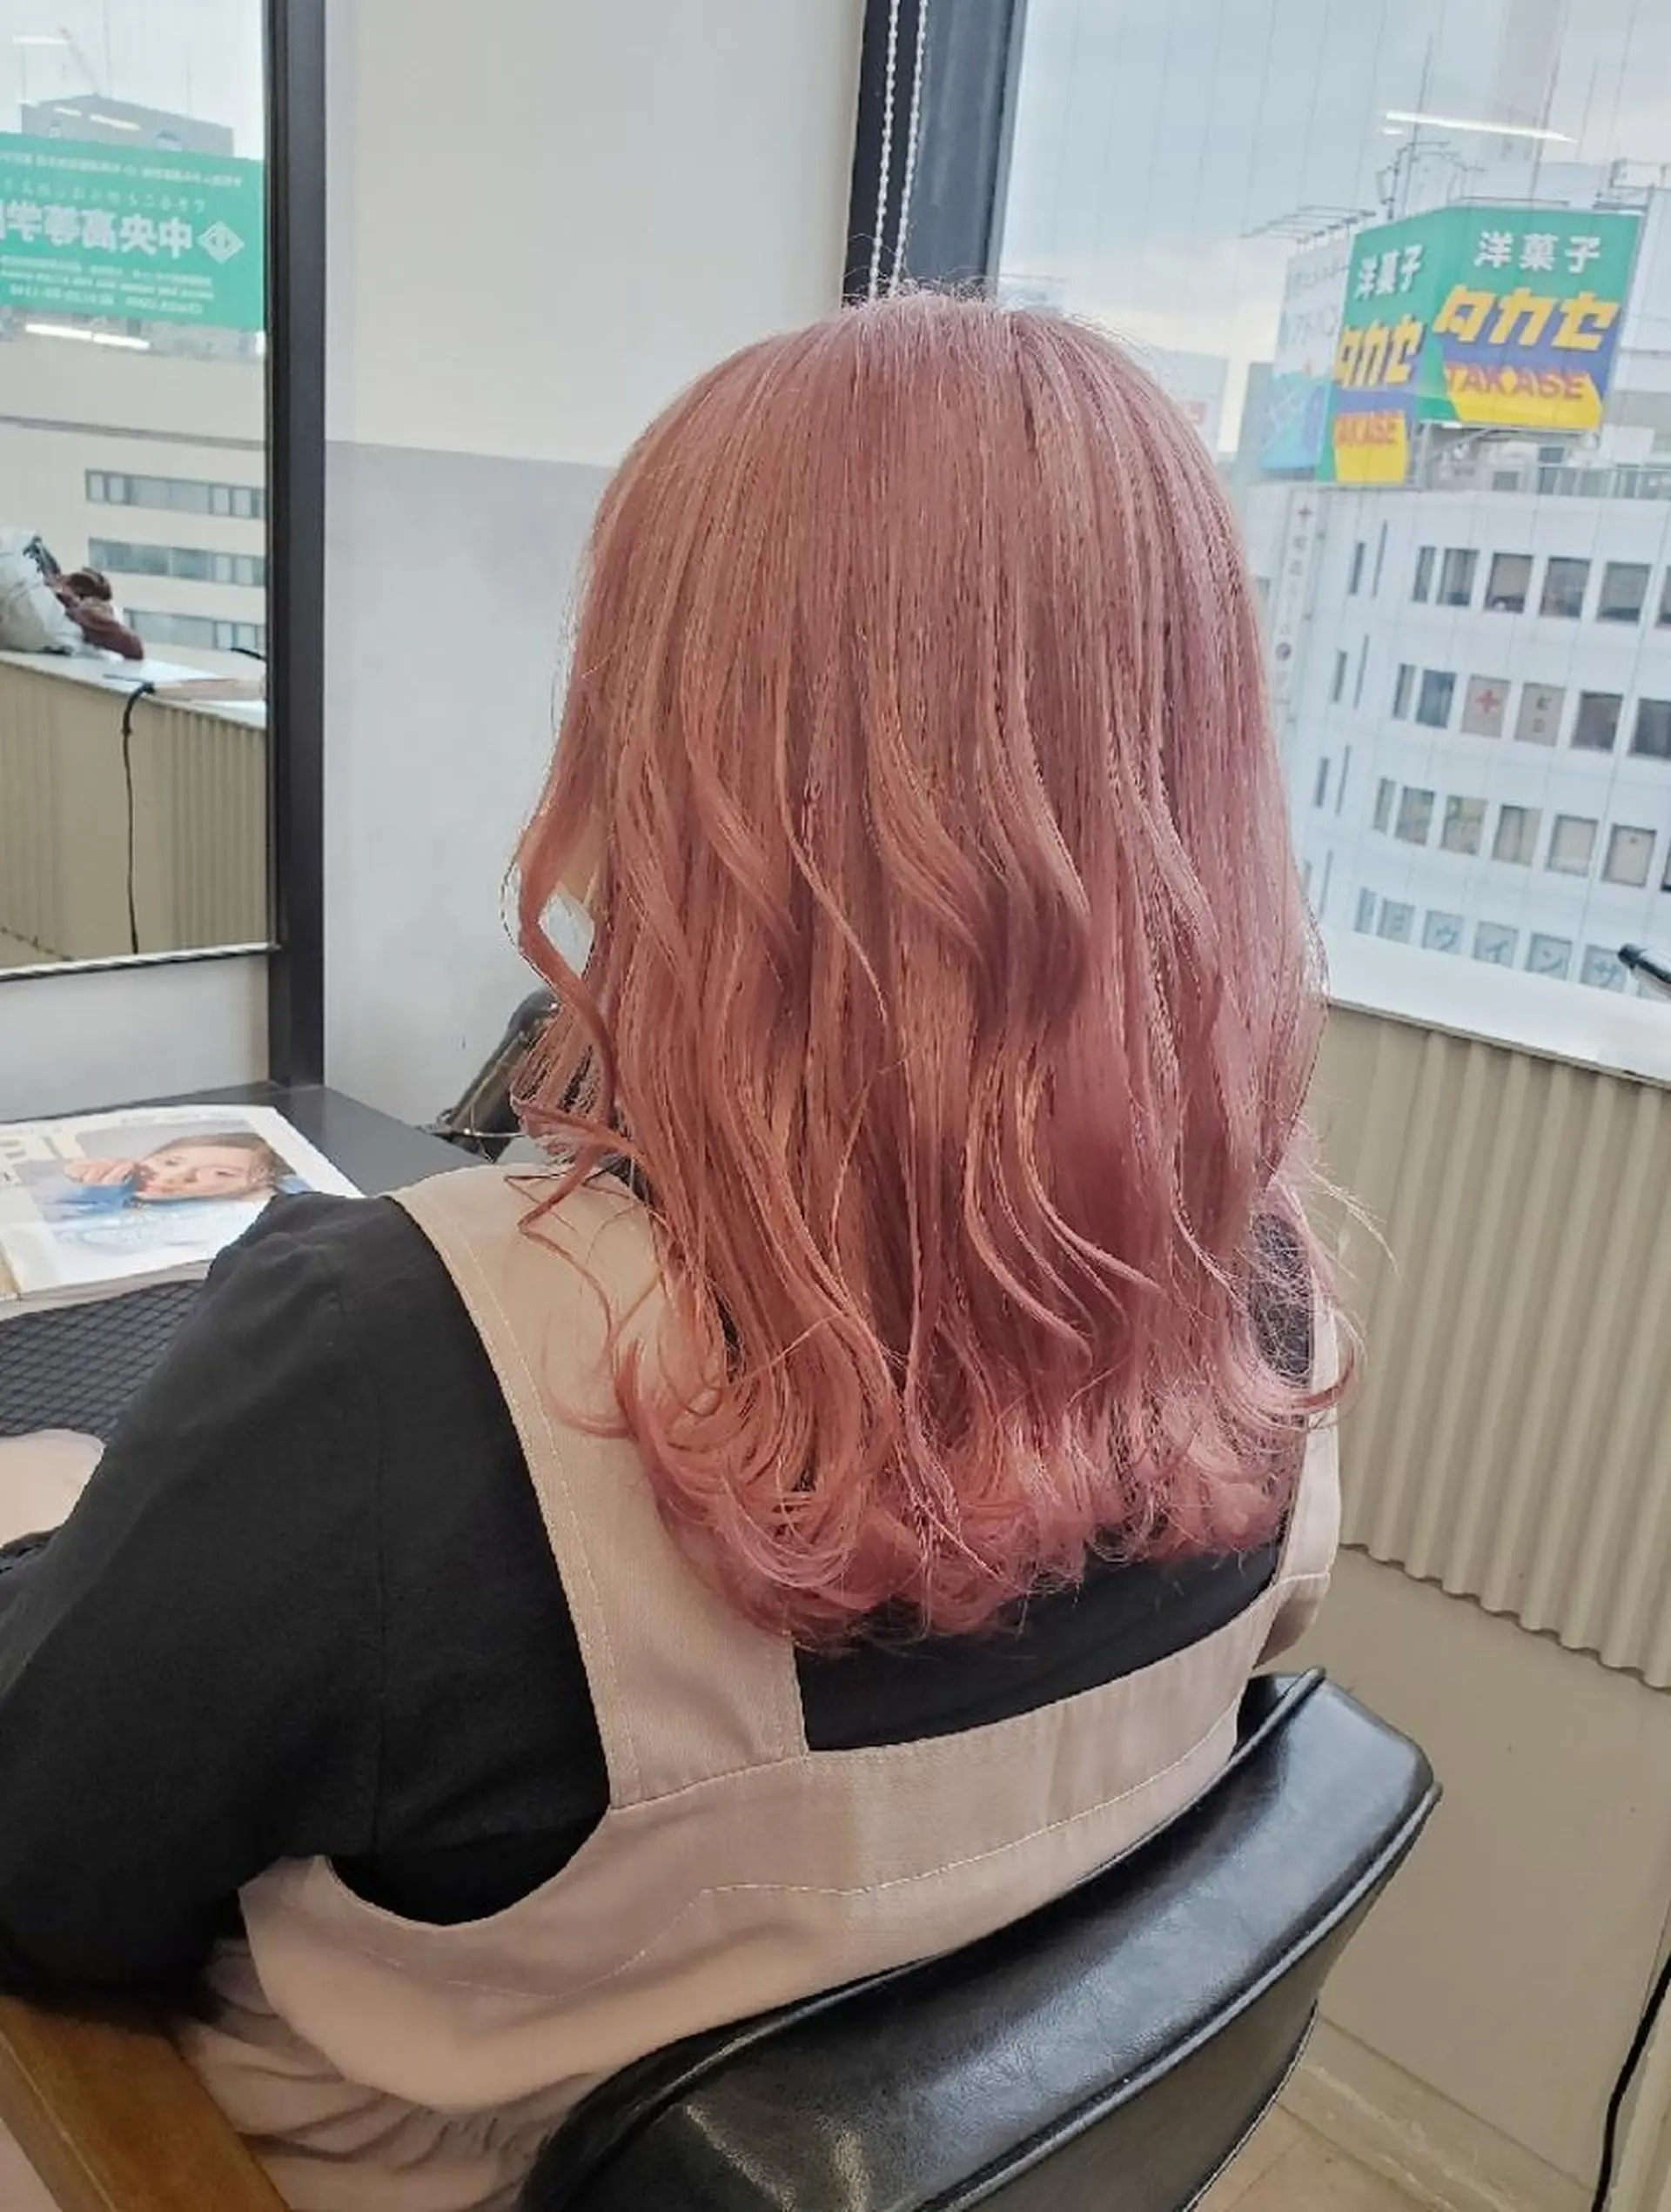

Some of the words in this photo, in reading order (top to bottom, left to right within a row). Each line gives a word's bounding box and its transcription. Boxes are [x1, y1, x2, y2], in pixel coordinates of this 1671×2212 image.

[1354, 244, 1423, 299] 洋菓子
[1474, 231, 1601, 274] 洋菓子
[1433, 285, 1620, 351] タカセ
[1333, 313, 1425, 387] タカセ
[1442, 362, 1585, 399] TAKASE
